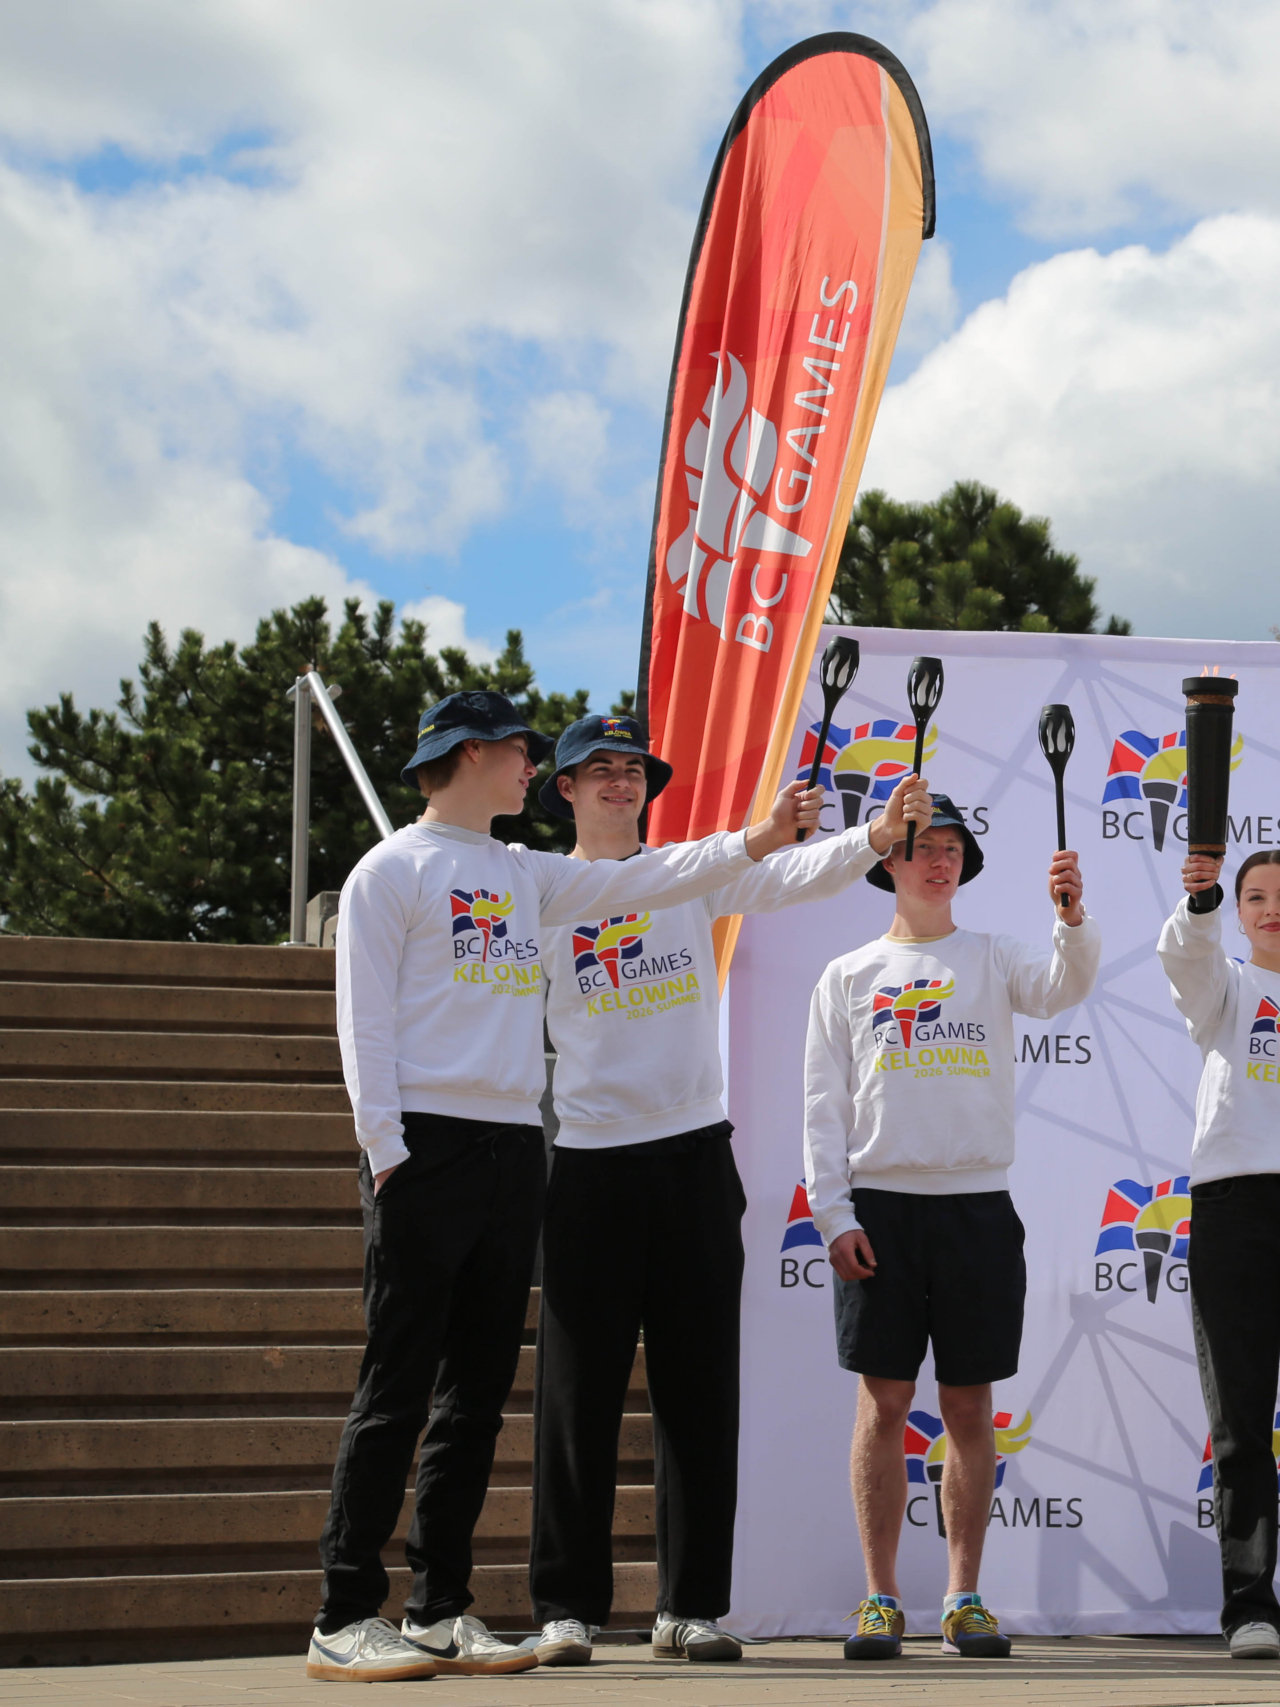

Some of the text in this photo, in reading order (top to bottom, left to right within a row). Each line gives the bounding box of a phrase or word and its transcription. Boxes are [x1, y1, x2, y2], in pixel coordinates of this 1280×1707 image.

[735, 275, 858, 653] BC GAMES
[1102, 810, 1145, 840] BC
[454, 936, 539, 960] BC GAES
[578, 948, 692, 994] BC GAMES
[586, 972, 700, 1018] KELOWNA
[626, 992, 701, 1020] 2026 SUMMER
[874, 1021, 986, 1050] BC GAMES
[1014, 1034, 1092, 1065] MES
[1249, 1037, 1277, 1056] BC
[874, 1046, 989, 1073] KELOWNA
[914, 1066, 991, 1078] 2026 SUMMER
[780, 1258, 825, 1288] BC
[1095, 1262, 1138, 1292] BC
[906, 1496, 1083, 1528] C AMES
